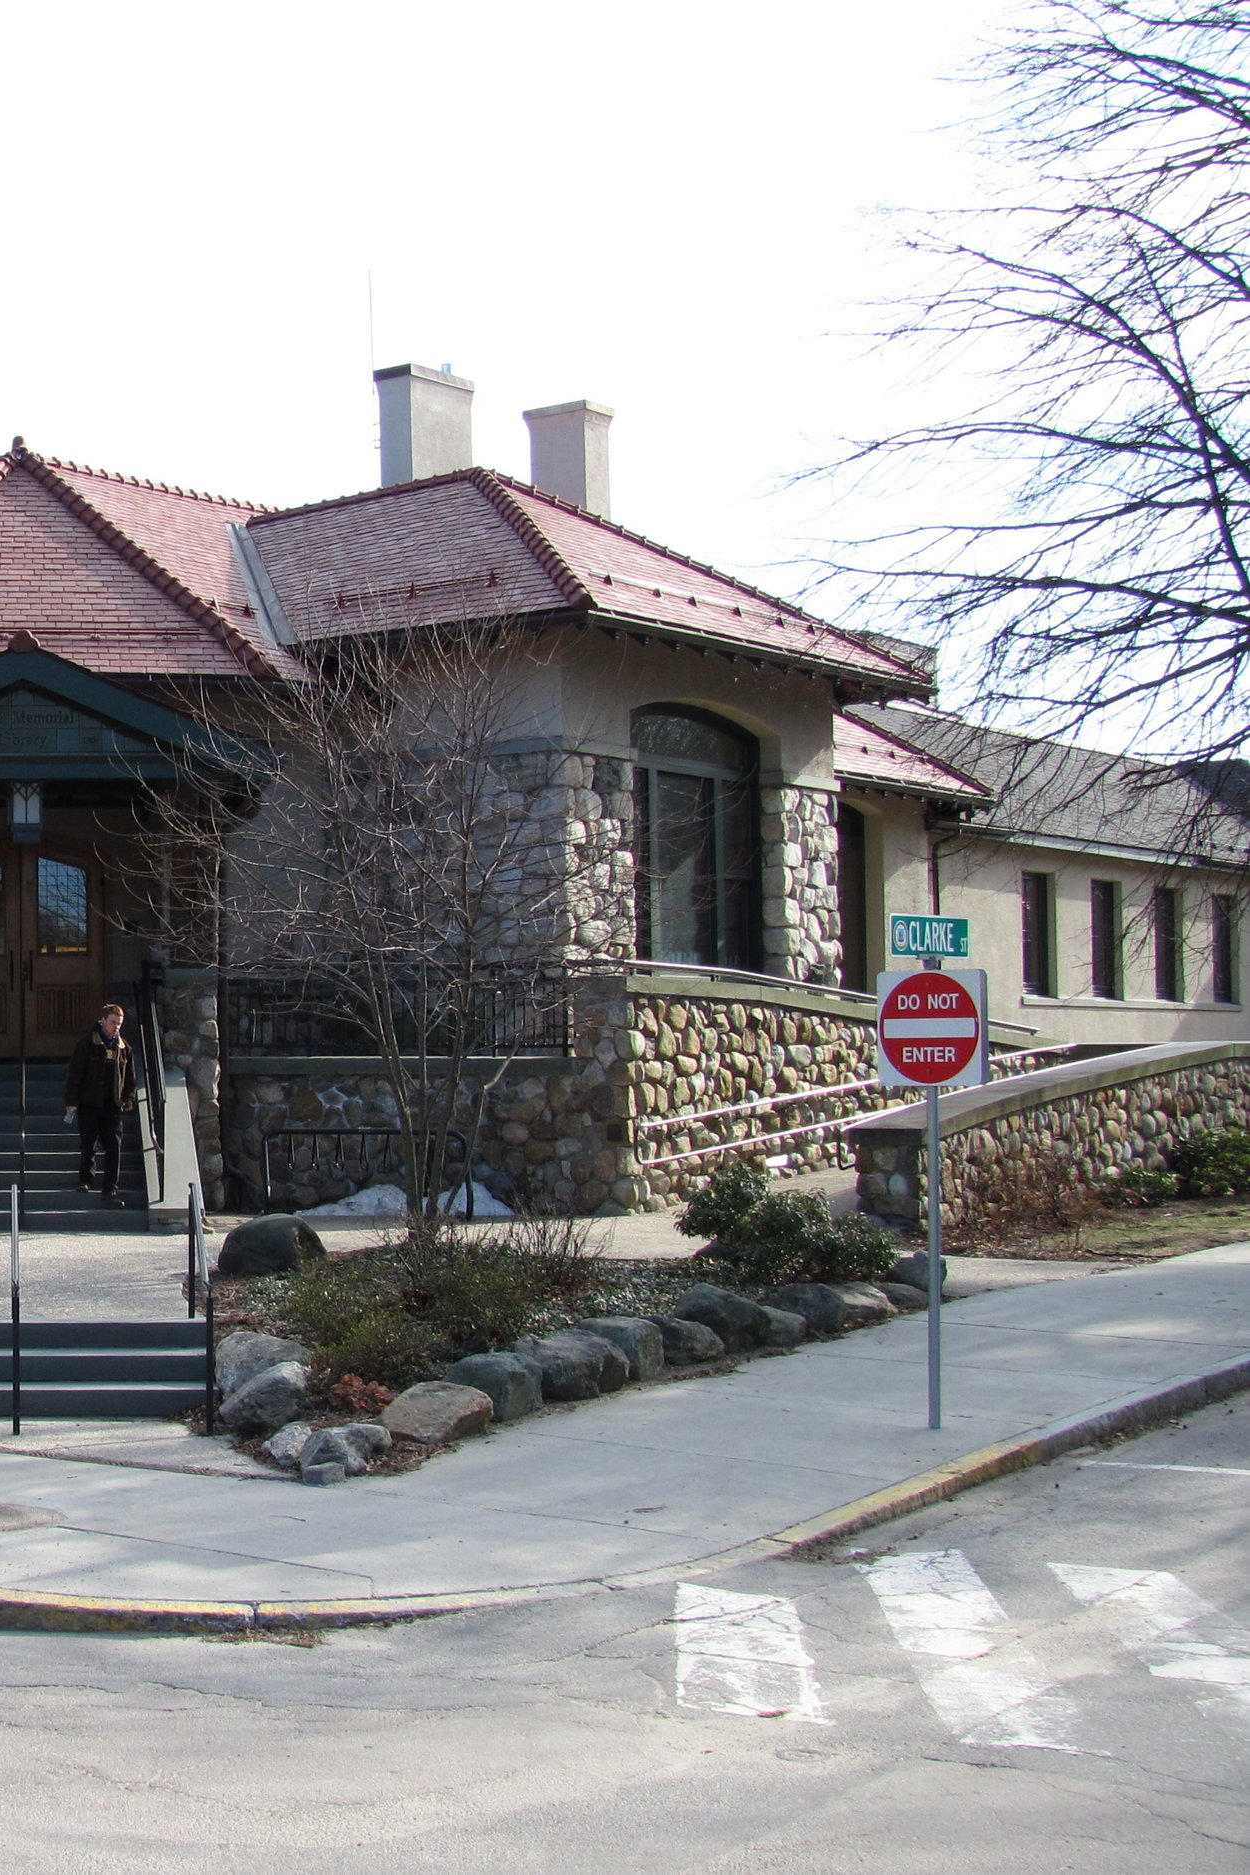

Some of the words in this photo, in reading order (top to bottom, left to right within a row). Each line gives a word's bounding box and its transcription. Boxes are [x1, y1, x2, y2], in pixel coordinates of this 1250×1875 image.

[12, 711, 75, 725] Memorial
[909, 921, 954, 952] CLARKE
[960, 937, 967, 953] ST
[897, 994, 920, 1010] DO
[927, 993, 959, 1010] NOT
[902, 1047, 956, 1063] ENTER
